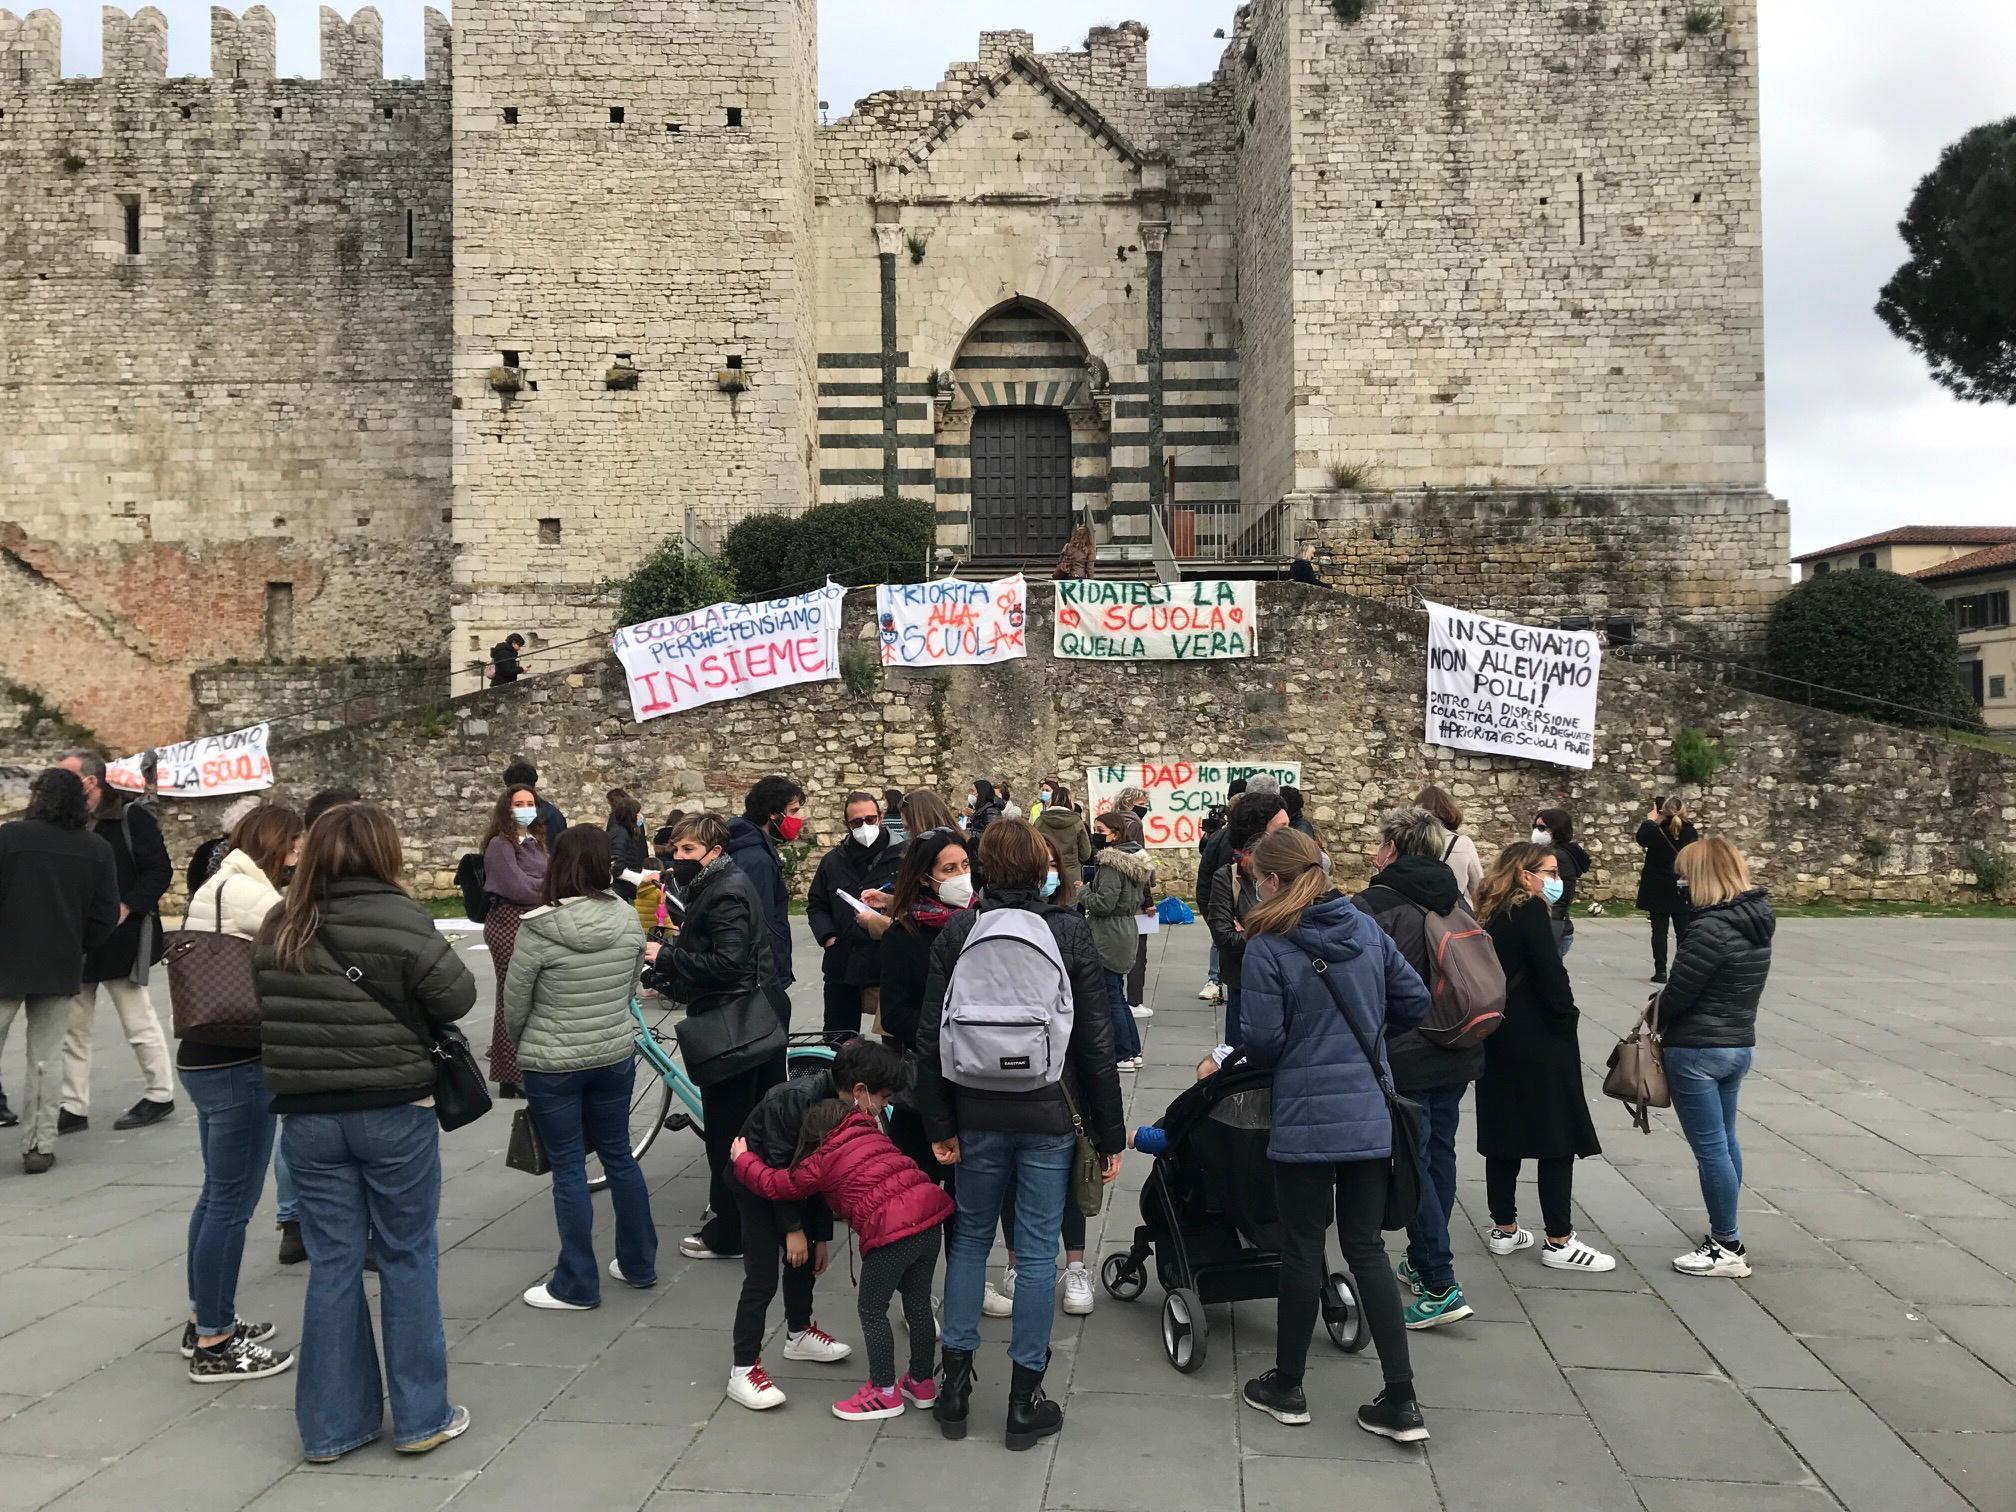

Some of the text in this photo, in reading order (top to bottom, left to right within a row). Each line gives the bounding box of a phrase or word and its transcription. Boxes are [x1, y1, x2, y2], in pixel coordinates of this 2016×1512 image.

[1194, 582, 1235, 606] LA
[633, 609, 722, 644] SCUOLA
[928, 602, 979, 627] ALLA
[1104, 606, 1225, 630] SCUOLA
[901, 621, 1010, 662] SCUOLA
[1060, 633, 1145, 657] QUELLA
[1431, 647, 1467, 672] NON
[635, 637, 827, 712] INSIEME
[1478, 699, 1492, 713] LA
[1501, 703, 1581, 729] DISPERSIONE
[1542, 725, 1591, 741] ADEGUATE
[1098, 762, 1296, 789] IN DAD HO IMPTO
